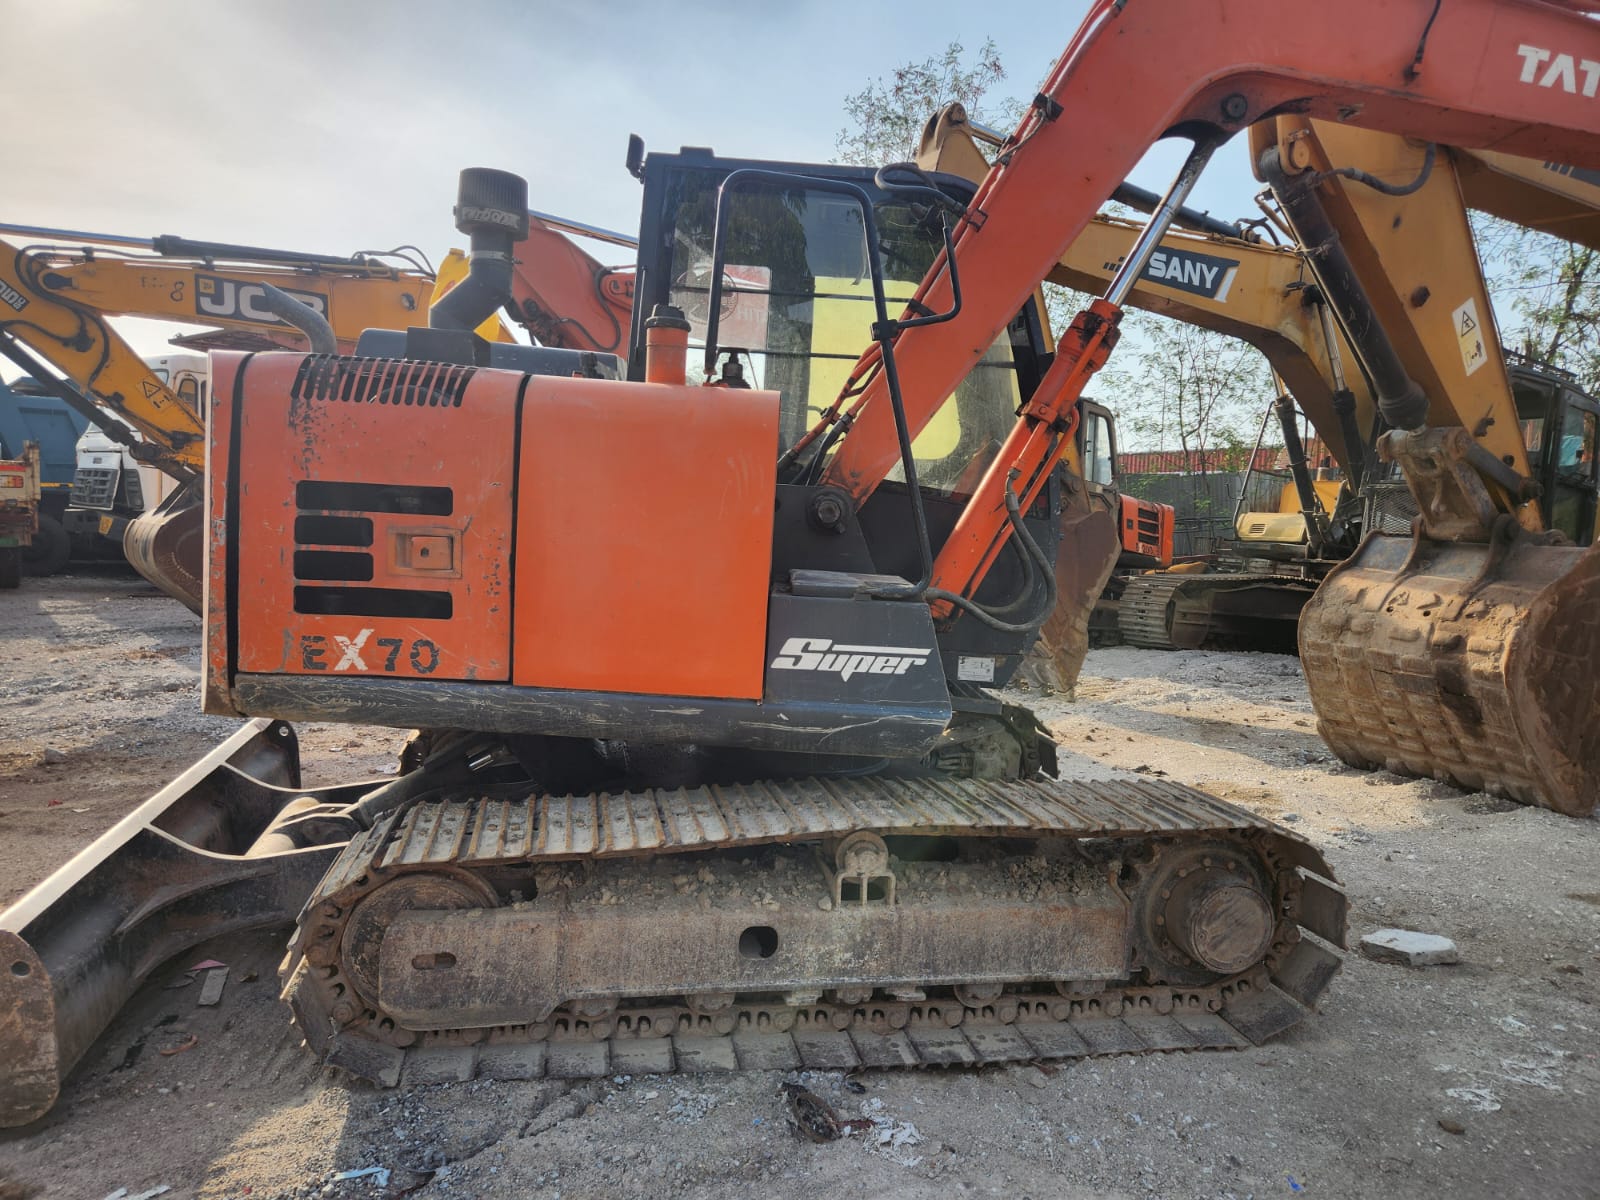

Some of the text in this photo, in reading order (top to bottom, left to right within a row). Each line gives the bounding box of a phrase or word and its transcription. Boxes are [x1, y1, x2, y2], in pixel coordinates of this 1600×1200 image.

[1148, 251, 1219, 289] SANY
[301, 628, 441, 674] EX70
[770, 637, 934, 682] Super
